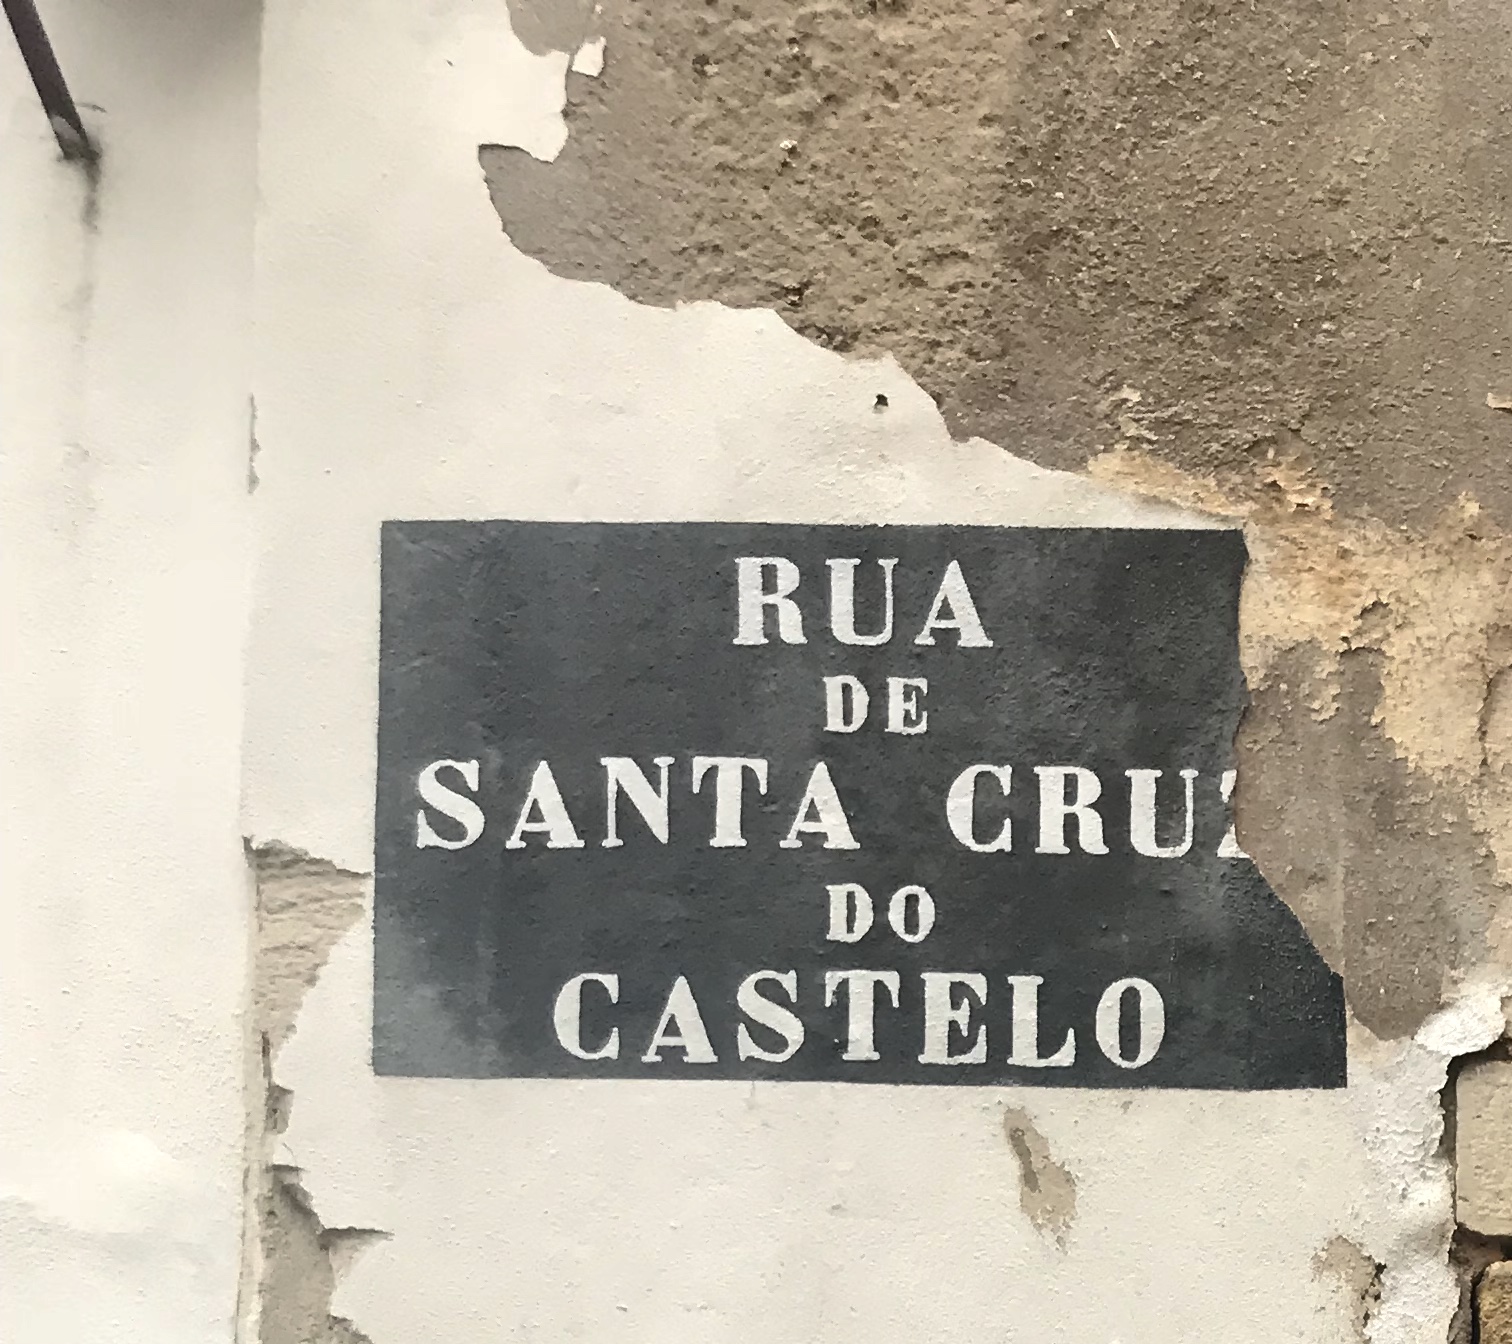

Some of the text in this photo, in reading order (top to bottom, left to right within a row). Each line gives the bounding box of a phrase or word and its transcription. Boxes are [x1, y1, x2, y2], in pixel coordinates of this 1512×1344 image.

[733, 557, 993, 647] RUA
[823, 675, 928, 735] DE
[415, 756, 861, 850] SANTA
[826, 883, 936, 943] DO
[553, 970, 1165, 1068] CASTELO
